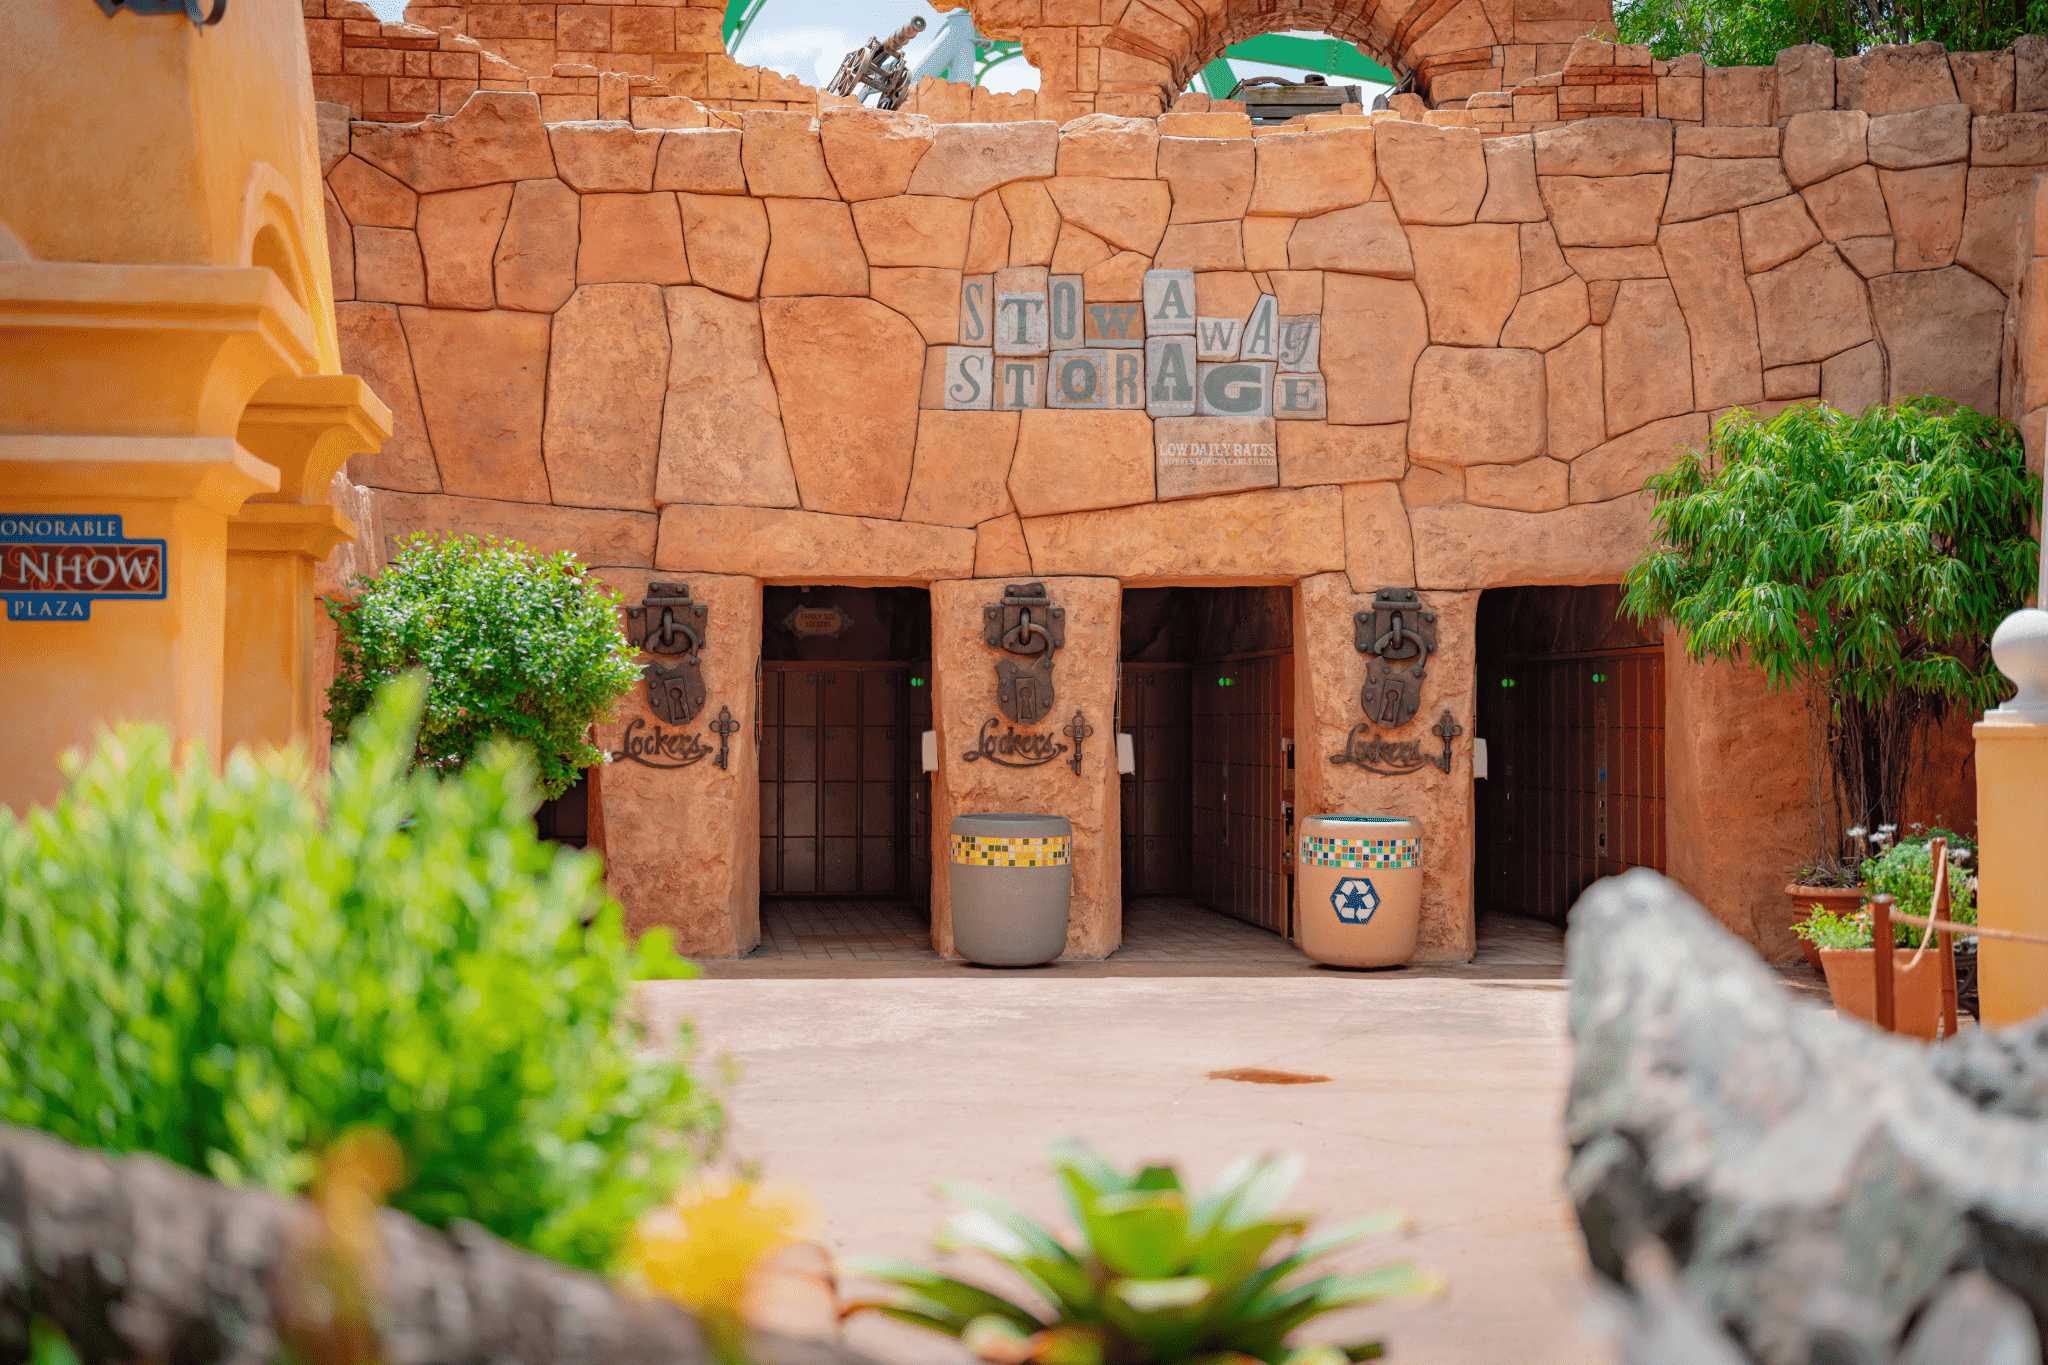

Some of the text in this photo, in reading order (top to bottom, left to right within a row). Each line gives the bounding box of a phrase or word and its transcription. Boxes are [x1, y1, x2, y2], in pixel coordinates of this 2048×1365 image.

[949, 343, 1319, 413] STORAGE
[1159, 443, 1276, 457] LOW DAILY RATES
[1196, 458, 1223, 466] LOWER
[1223, 458, 1252, 466] YEARLY
[1253, 458, 1276, 466] RATES
[1, 520, 117, 537] ONORABLE
[14, 600, 84, 617] PLAZA
[610, 718, 714, 769] Lockers
[963, 717, 1068, 768] Lockers
[1329, 722, 1437, 775] Lockers
